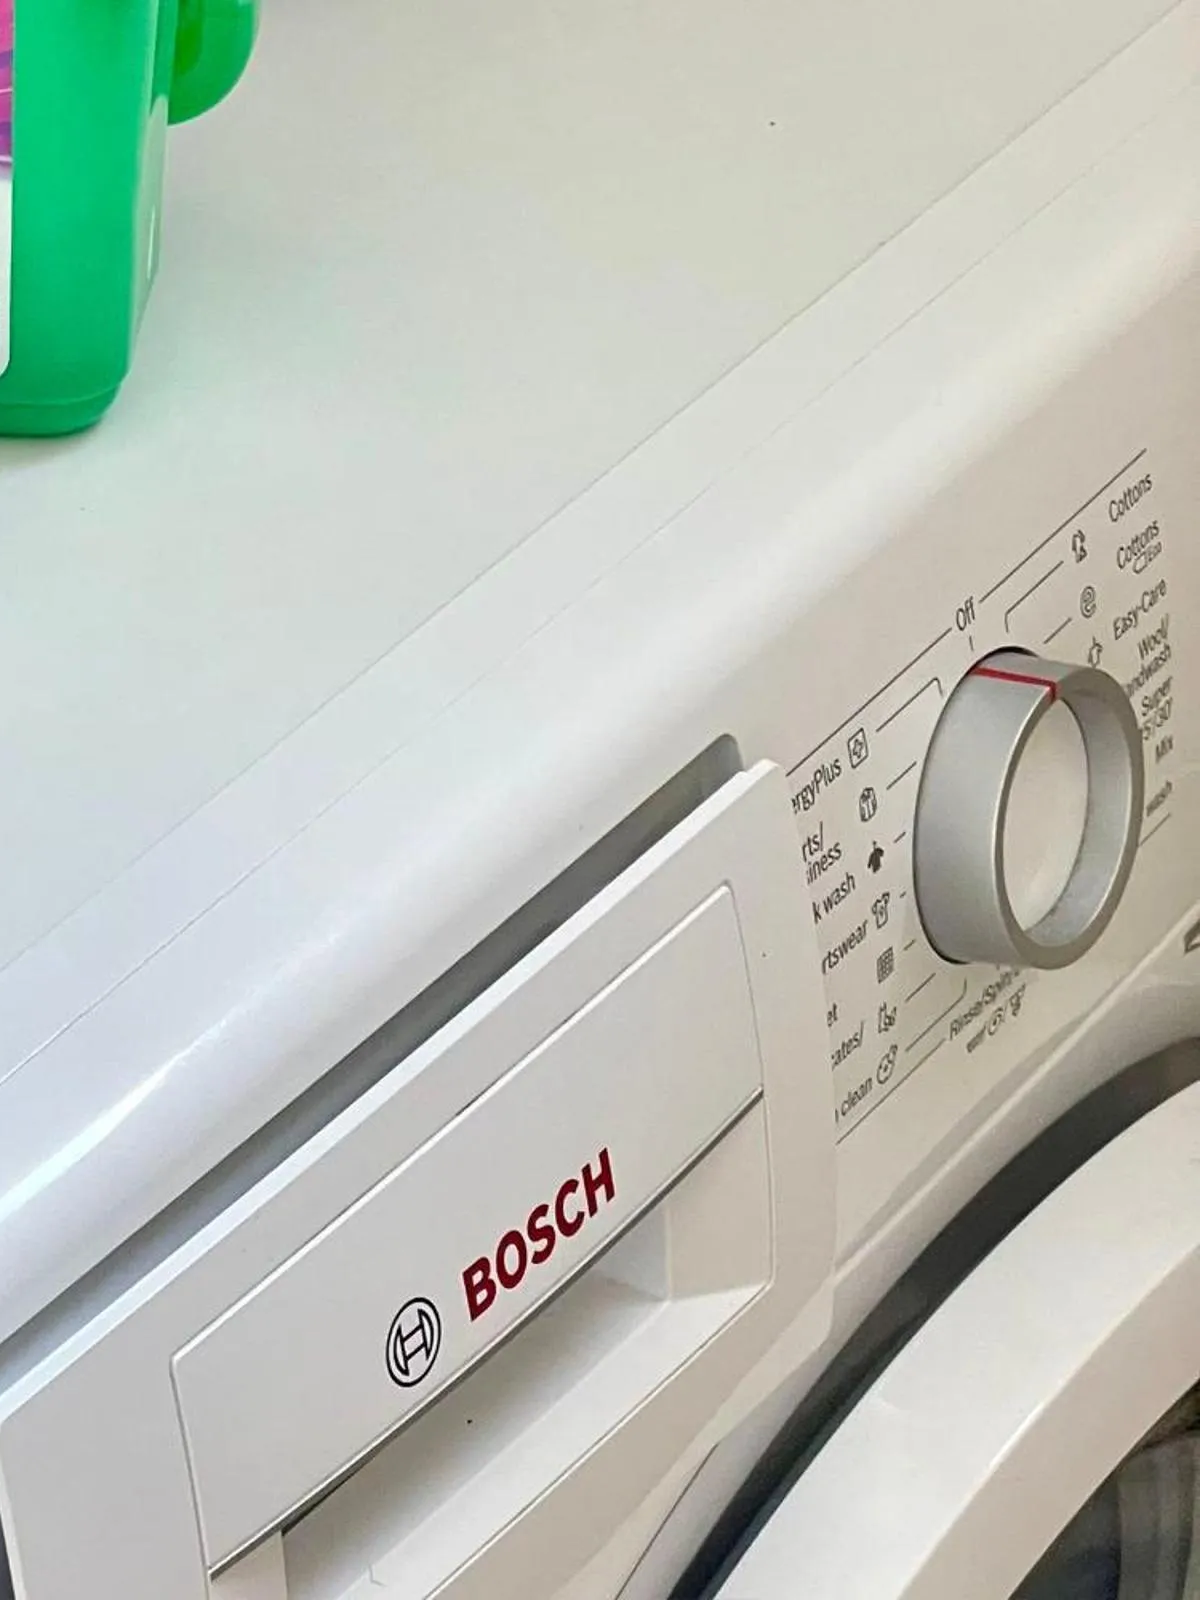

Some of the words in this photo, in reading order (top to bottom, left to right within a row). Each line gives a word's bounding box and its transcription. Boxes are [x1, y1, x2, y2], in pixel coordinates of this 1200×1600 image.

[1108, 473, 1153, 522] Cottons
[1116, 519, 1160, 570] Cottons
[955, 595, 976, 631] Off
[1113, 578, 1167, 640] Easy-Care
[806, 841, 843, 886] iness
[822, 871, 857, 915] wash
[841, 1076, 873, 1117] clean
[461, 1147, 616, 1323] BOSCH
